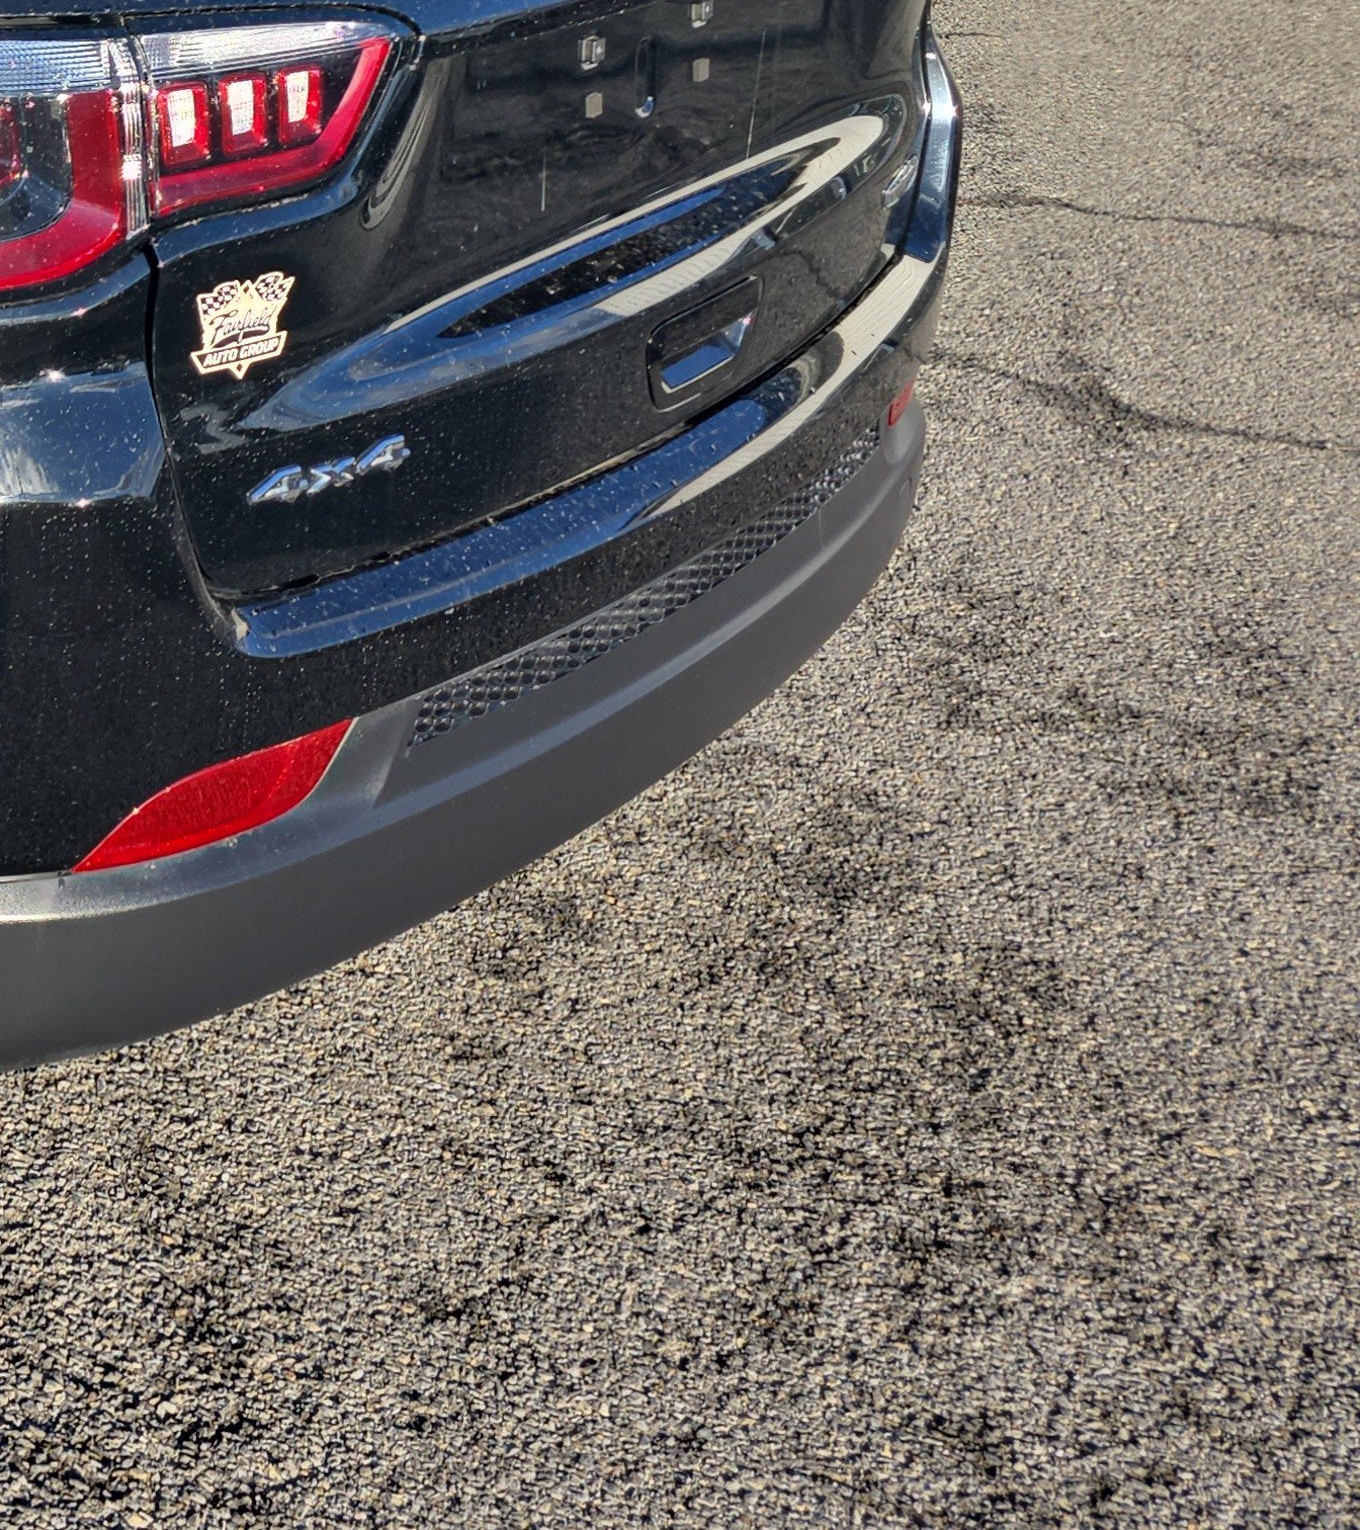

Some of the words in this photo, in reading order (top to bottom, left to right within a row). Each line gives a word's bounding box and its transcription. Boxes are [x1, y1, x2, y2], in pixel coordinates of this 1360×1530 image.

[209, 307, 277, 346] Fairfield
[203, 348, 239, 368] AUTO
[240, 337, 280, 361] GROUP
